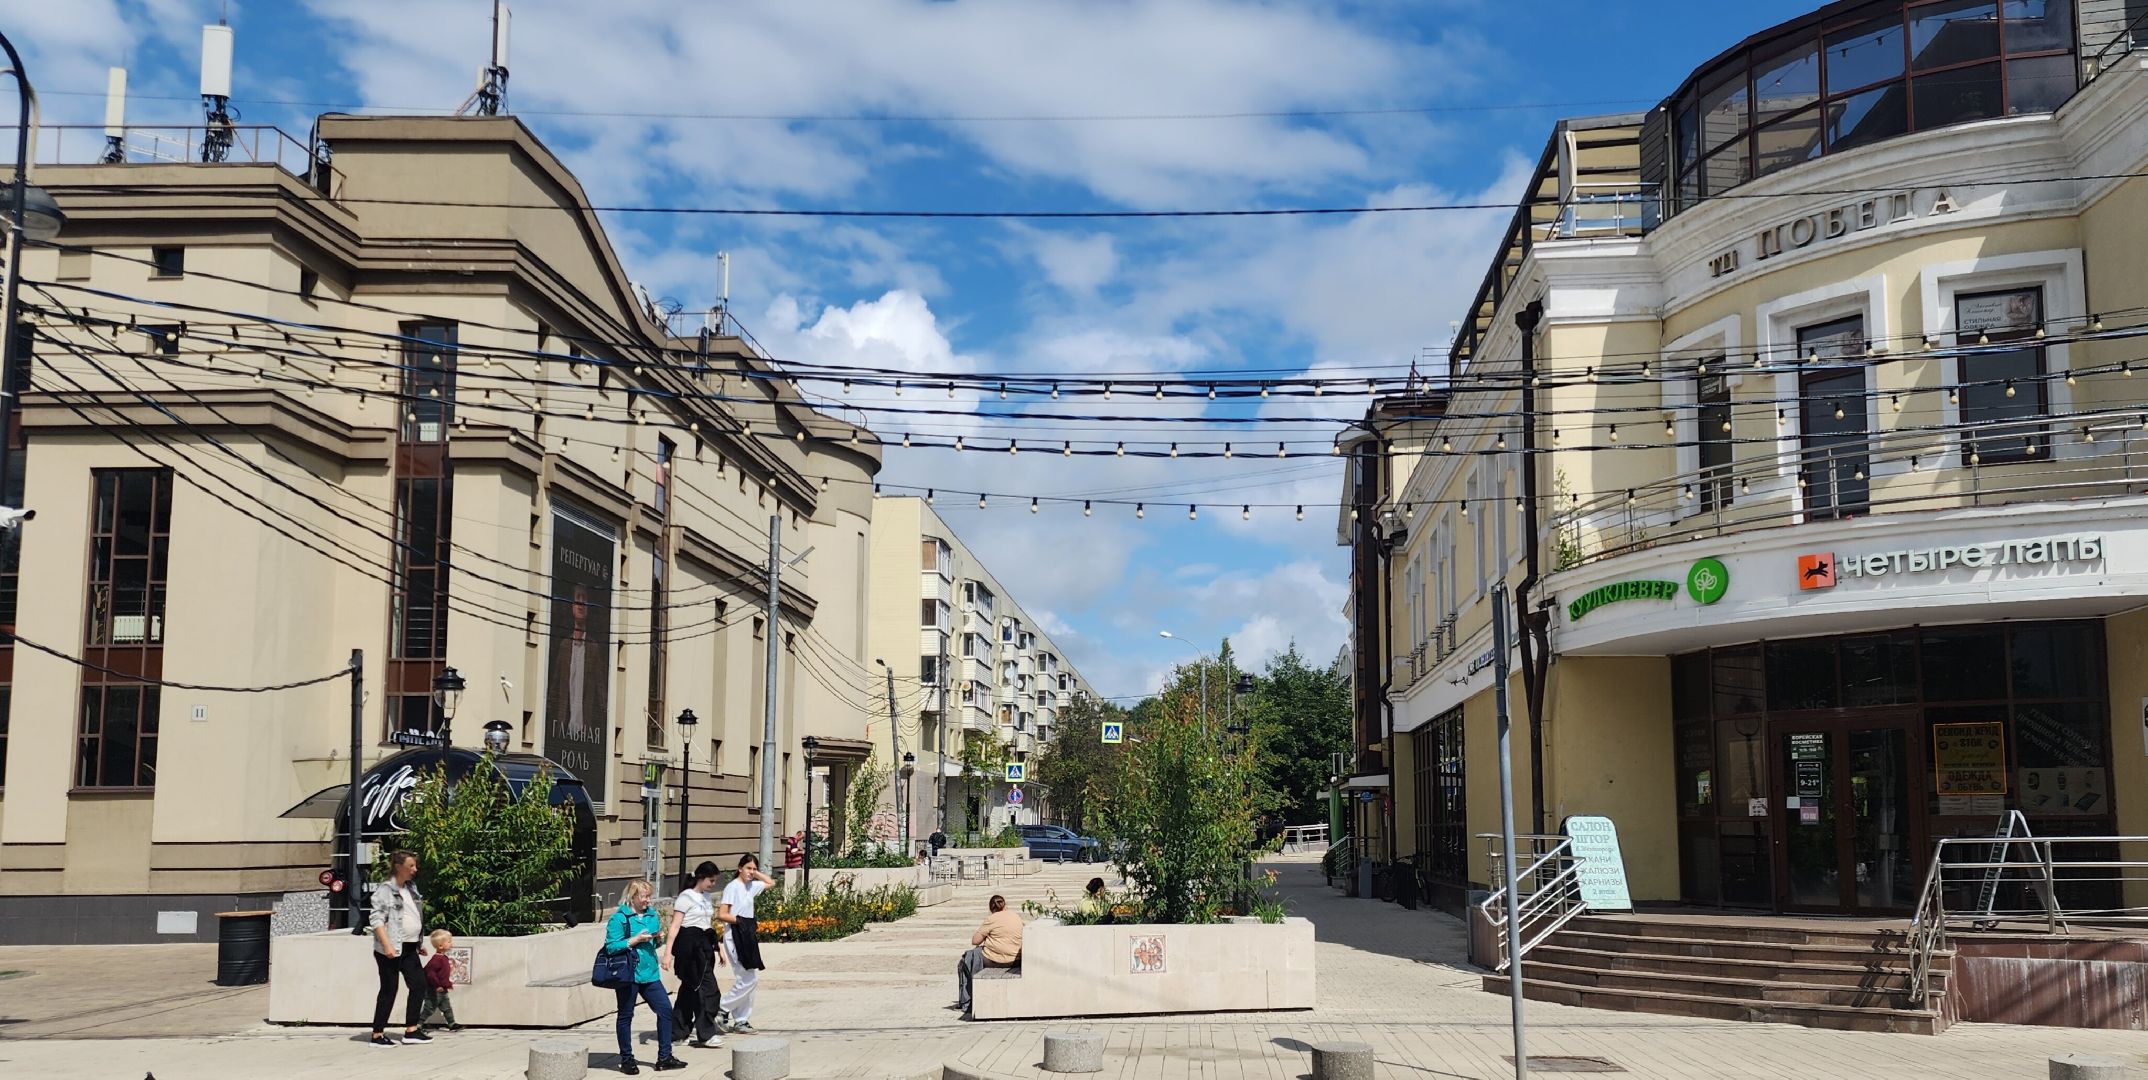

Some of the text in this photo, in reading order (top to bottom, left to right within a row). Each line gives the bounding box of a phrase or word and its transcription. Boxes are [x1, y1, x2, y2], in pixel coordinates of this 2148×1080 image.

[1756, 189, 1961, 259] ПОБЕДА
[560, 546, 601, 576] РЕПЕРТУАР
[1842, 536, 2102, 578] четыре лапы
[1567, 580, 1677, 621] КУУЛКЛЕВЕР
[552, 719, 601, 745] ГЛАВНАЯ
[561, 749, 590, 771] РОЛЬ
[1570, 821, 1612, 832] САЛОН
[1575, 834, 1610, 844] ШТОР
